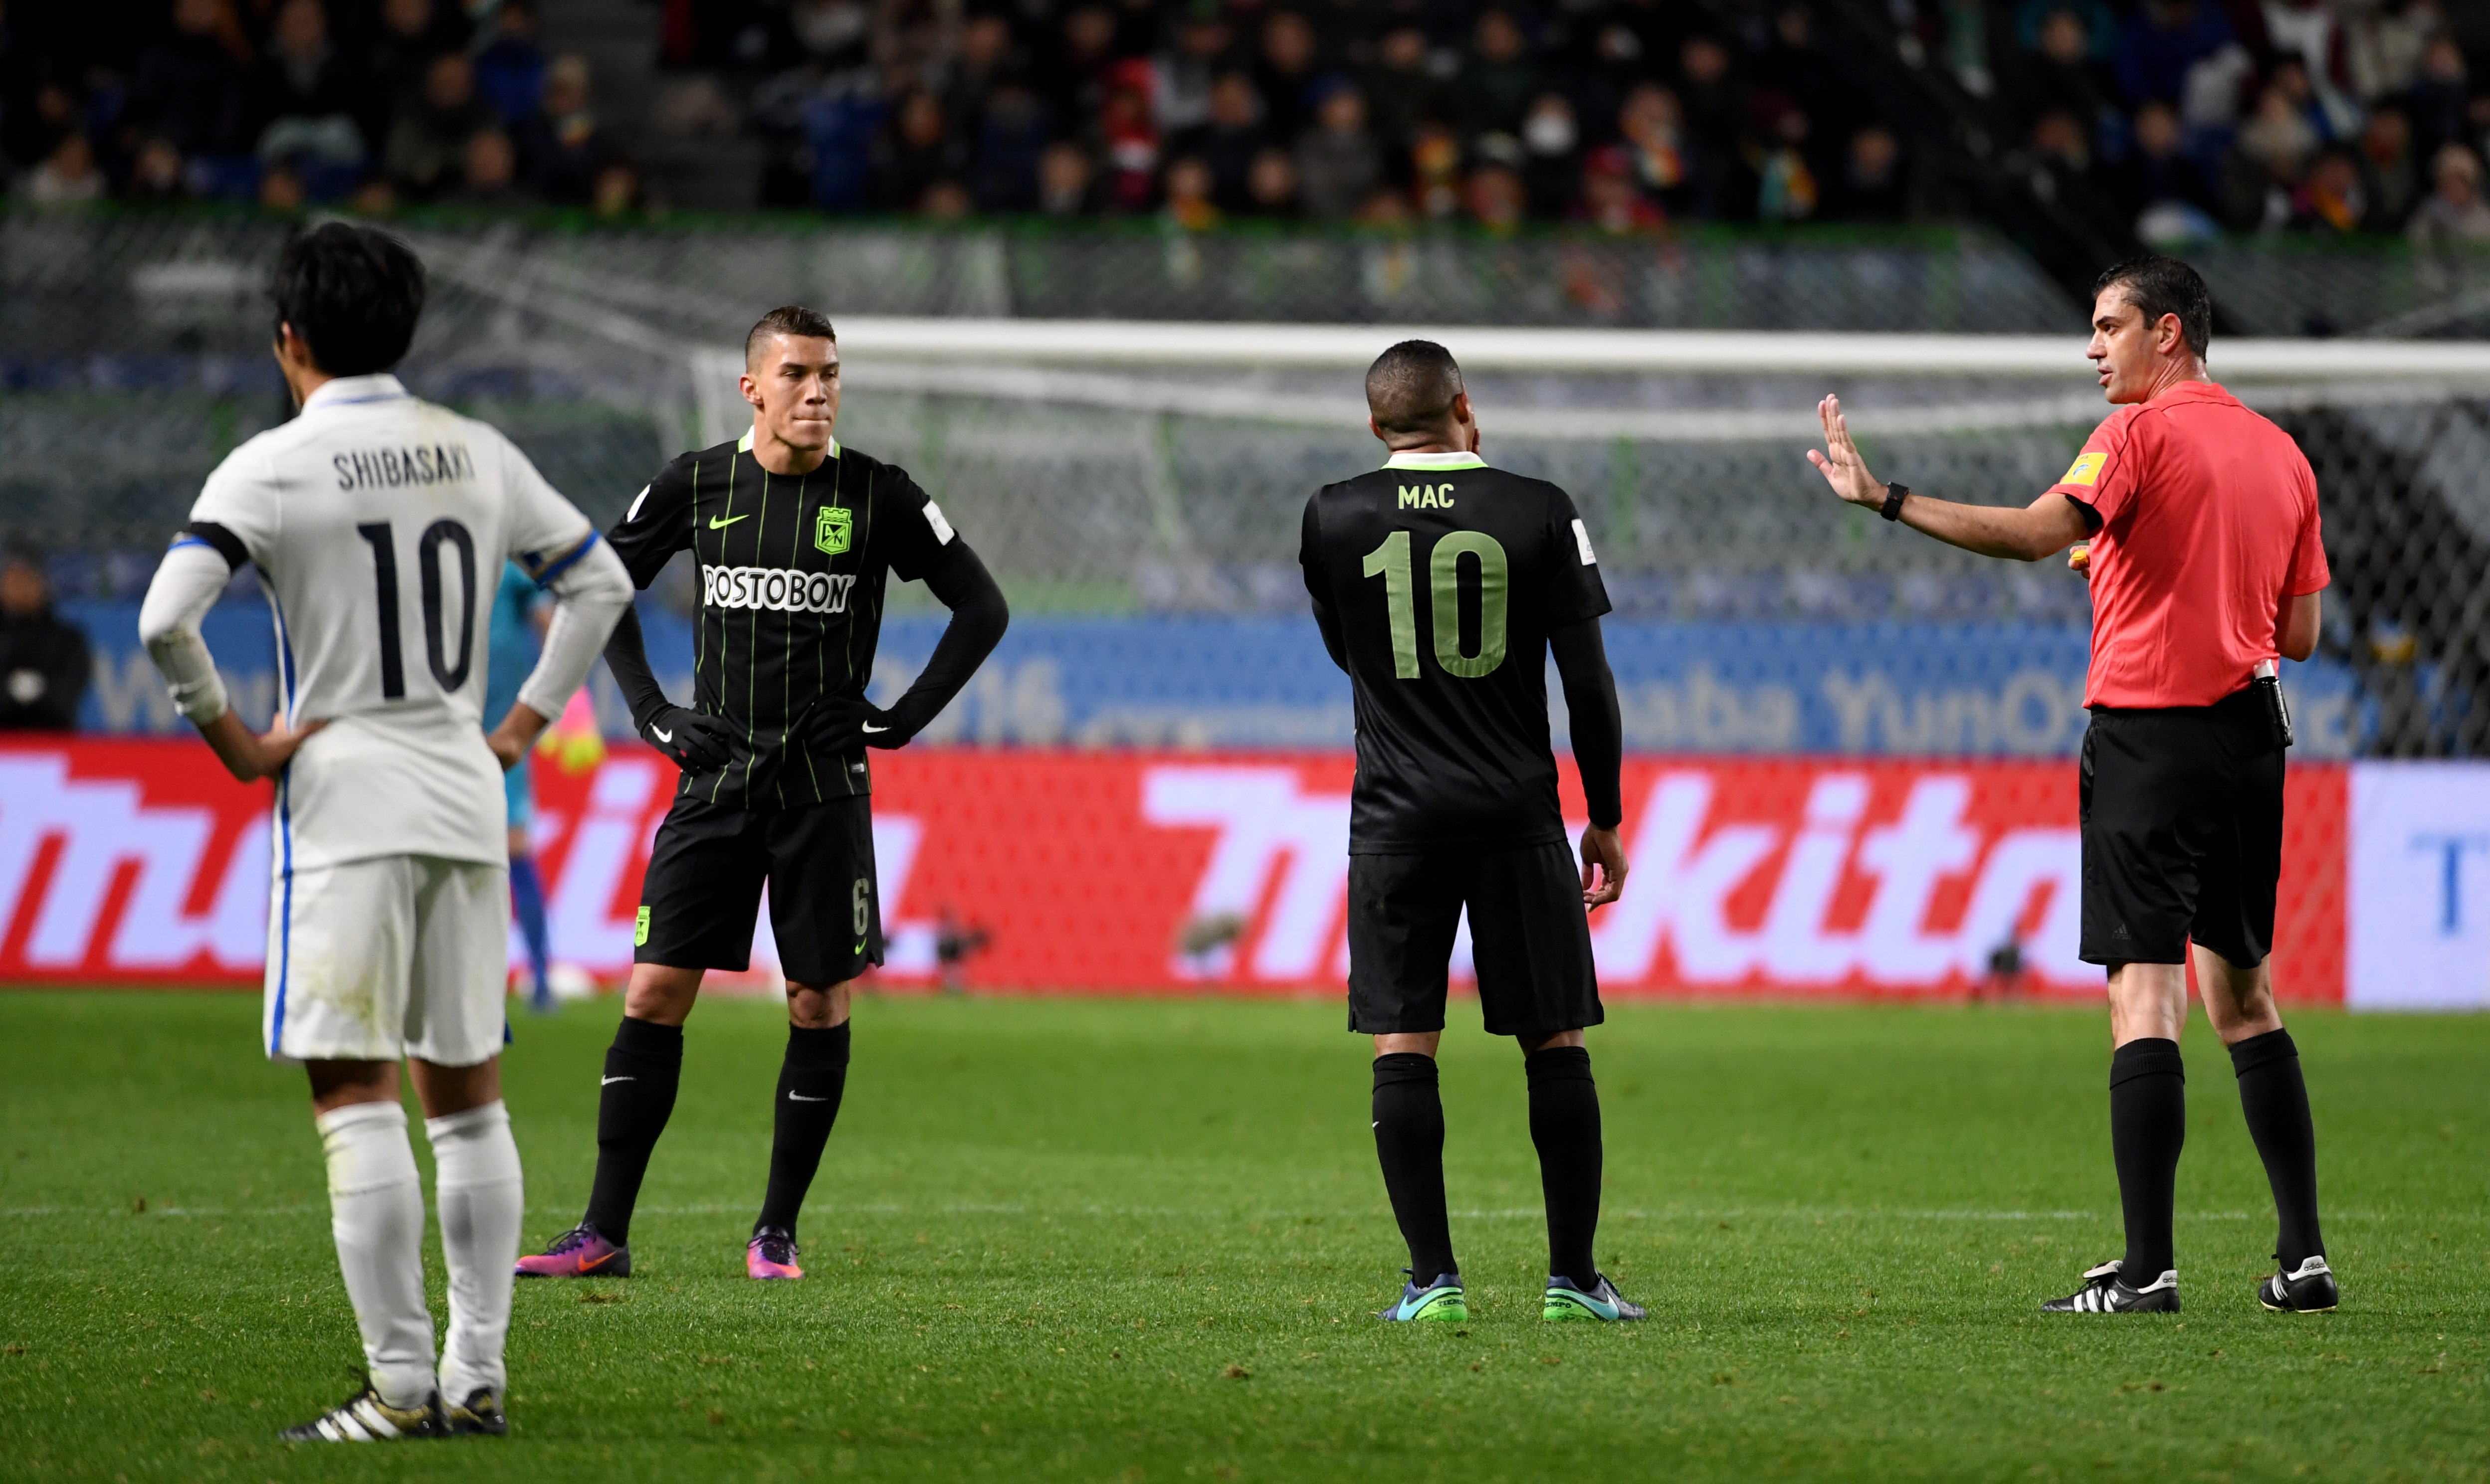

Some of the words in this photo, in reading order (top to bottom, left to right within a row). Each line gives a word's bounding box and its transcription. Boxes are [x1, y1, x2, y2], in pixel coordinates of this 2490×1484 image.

[1398, 483, 1454, 510] MAC
[357, 518, 476, 700] 10
[703, 567, 850, 610] POSTOBON
[1362, 530, 1508, 679] 10
[1820, 667, 2089, 752] YunO
[852, 878, 869, 935] 6
[1140, 766, 2109, 980] Mkita
[1437, 1298, 1465, 1307] TIEMP
